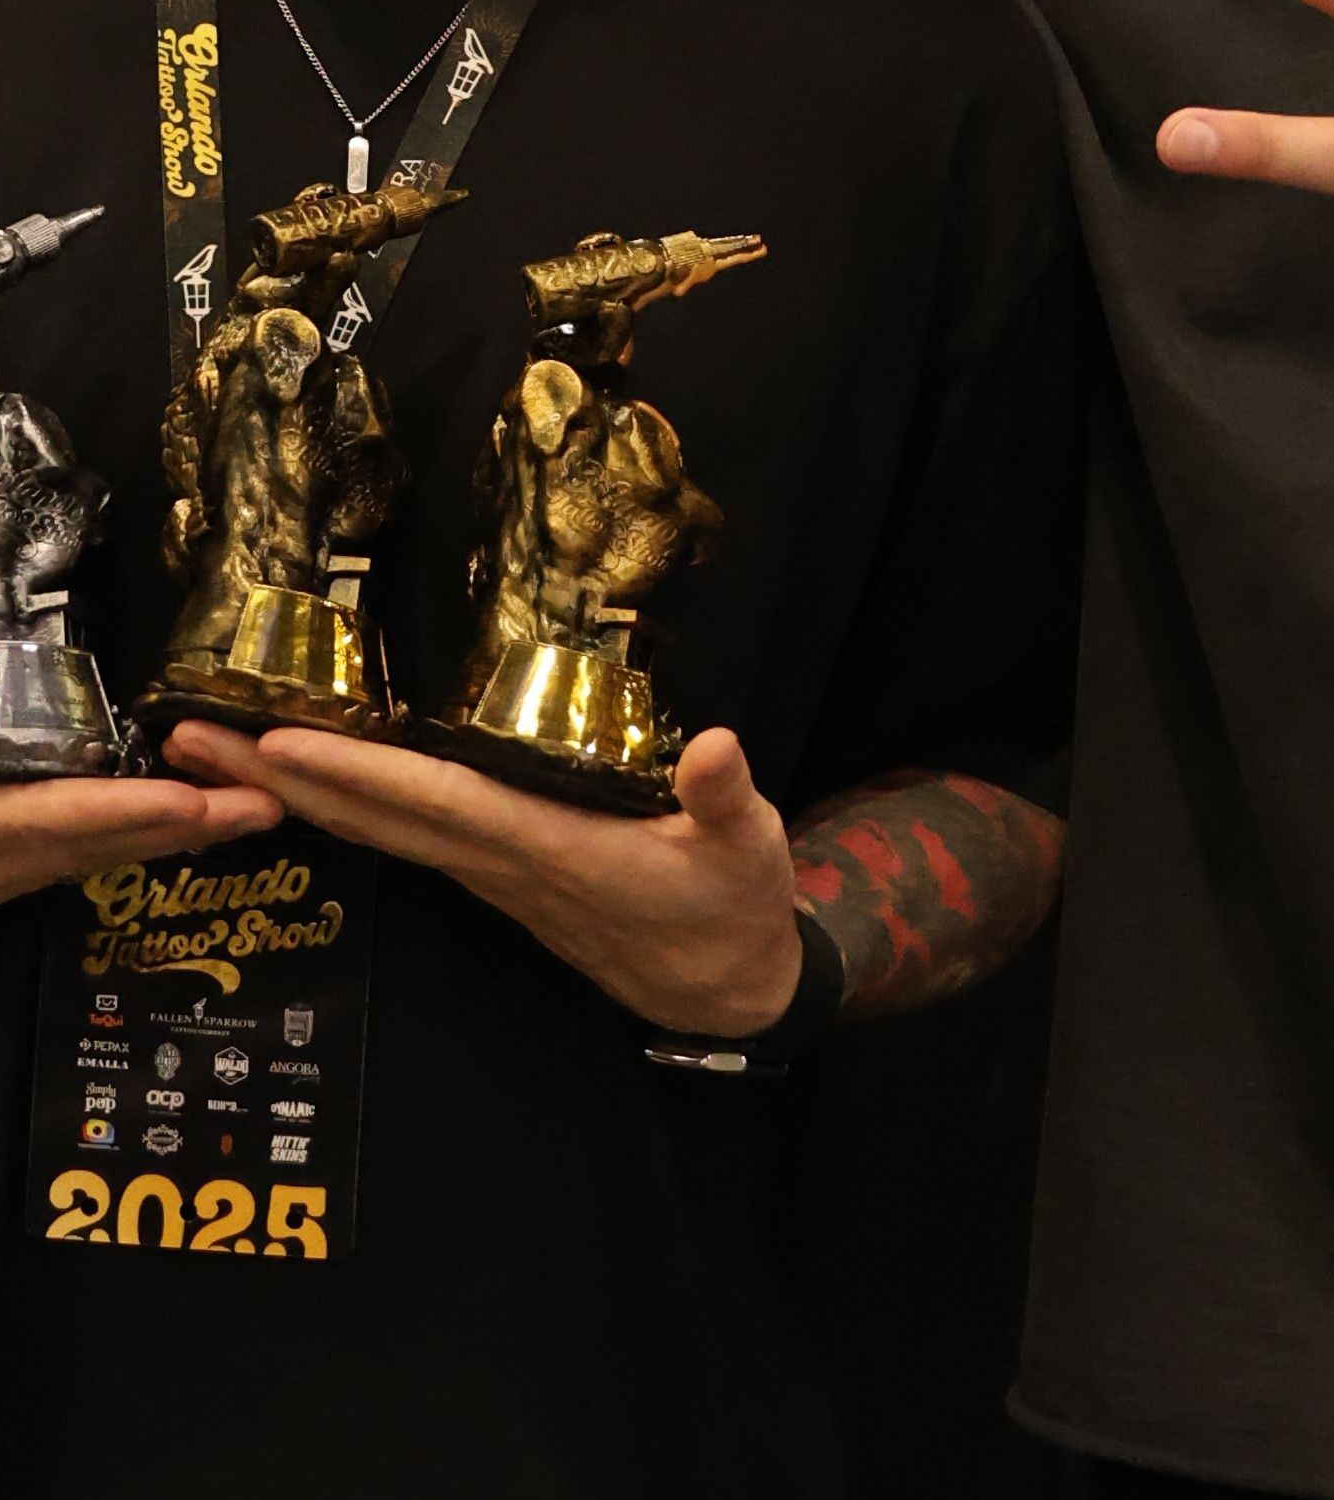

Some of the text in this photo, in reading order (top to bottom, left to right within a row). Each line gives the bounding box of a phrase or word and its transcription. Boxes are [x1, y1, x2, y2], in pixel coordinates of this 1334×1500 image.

[178, 22, 223, 176] Orlando
[158, 28, 196, 198] Tattoo Show
[82, 858, 312, 928] Orlando
[81, 900, 345, 976] Tattoo Show
[149, 1012, 259, 1029] FALLEN SPARROW
[93, 1040, 130, 1053] PEPAX
[77, 1057, 129, 1070] EMALLA
[269, 1061, 320, 1075] ANGORA
[270, 1100, 316, 1117] DYNAMIC
[269, 1148, 308, 1163] SKINS
[45, 1168, 329, 1260] 2025
